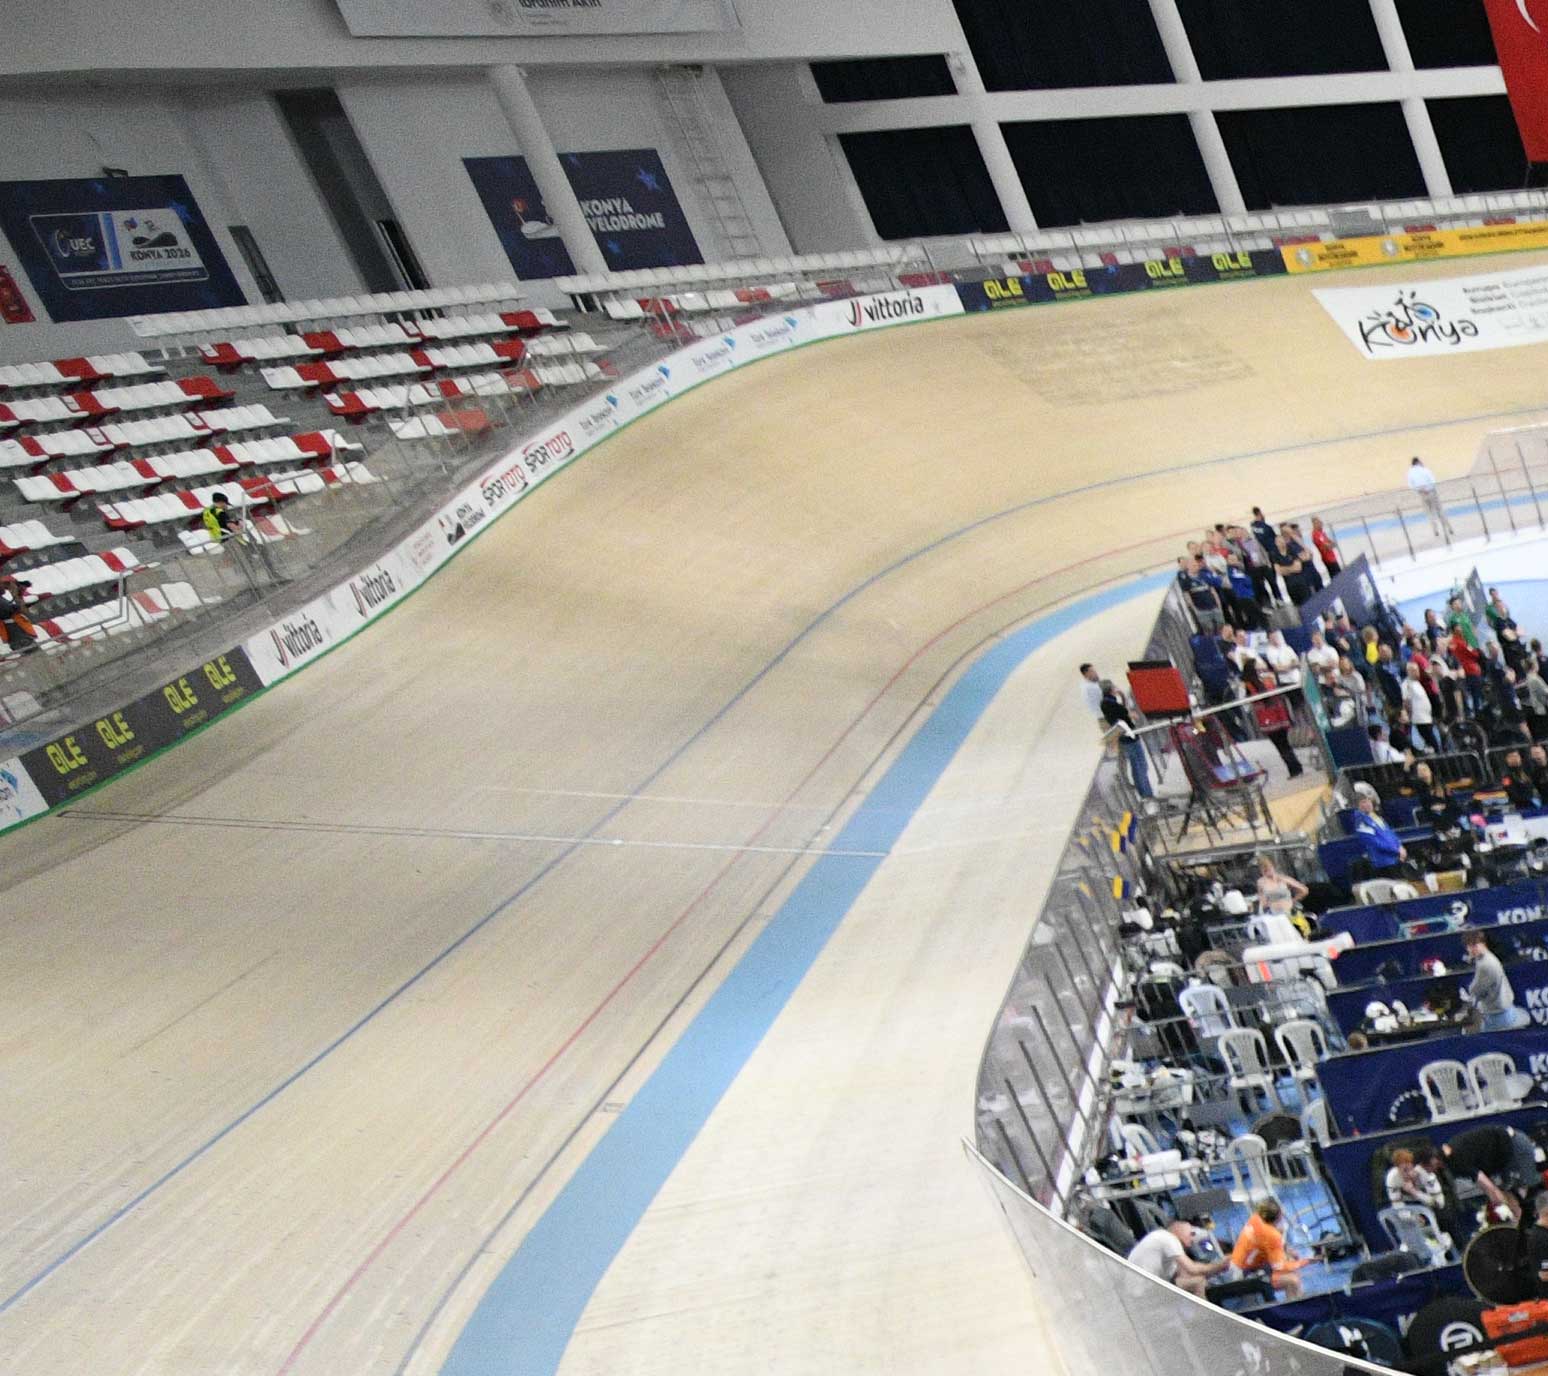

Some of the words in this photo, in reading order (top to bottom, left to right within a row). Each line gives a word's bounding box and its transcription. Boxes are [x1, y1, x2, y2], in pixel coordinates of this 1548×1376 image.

[581, 197, 634, 215] KONYA
[587, 213, 666, 232] VELODROME
[865, 293, 925, 322] vittoria
[363, 568, 399, 611] vittoria
[283, 615, 324, 658] vittoria
